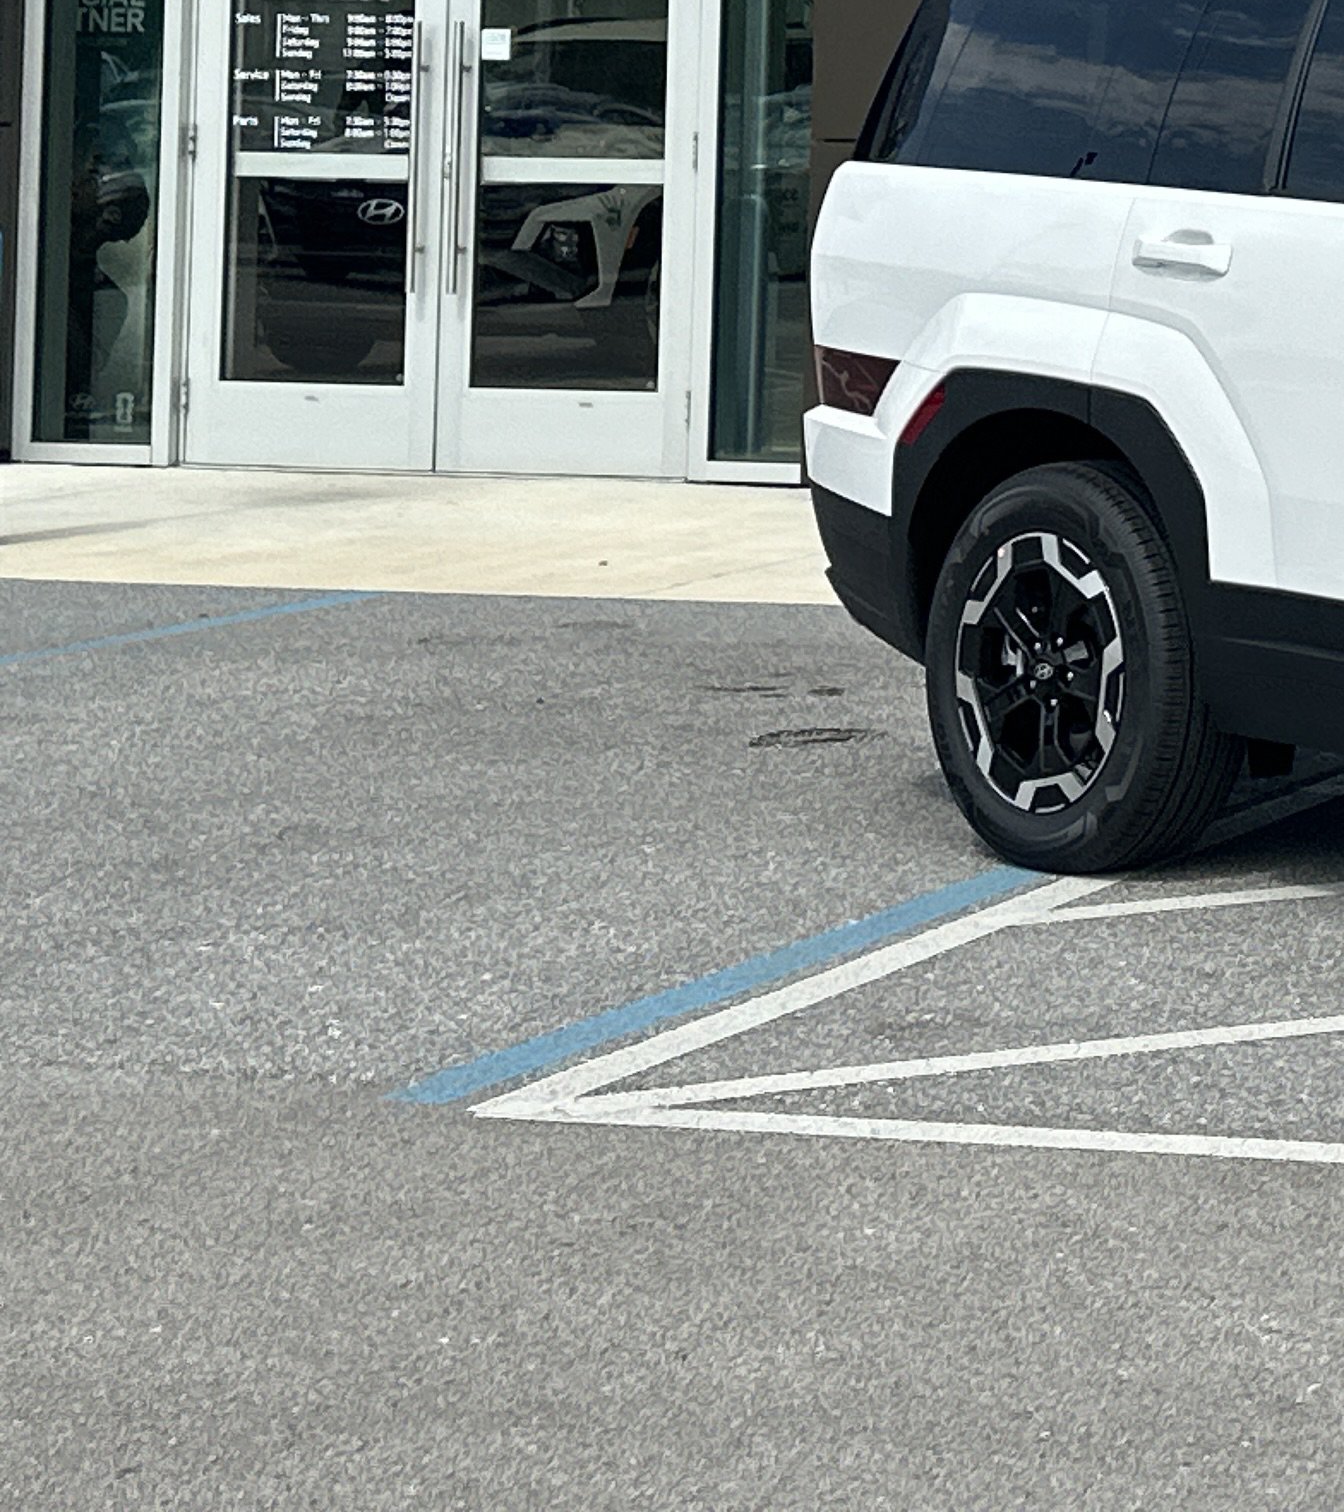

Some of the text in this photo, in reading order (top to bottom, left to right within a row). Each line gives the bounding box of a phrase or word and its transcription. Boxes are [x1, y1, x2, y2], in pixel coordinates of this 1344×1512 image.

[77, 7, 145, 32] TNER
[235, 13, 262, 24] Sales
[233, 68, 269, 80] Service
[233, 115, 258, 126] Parts
